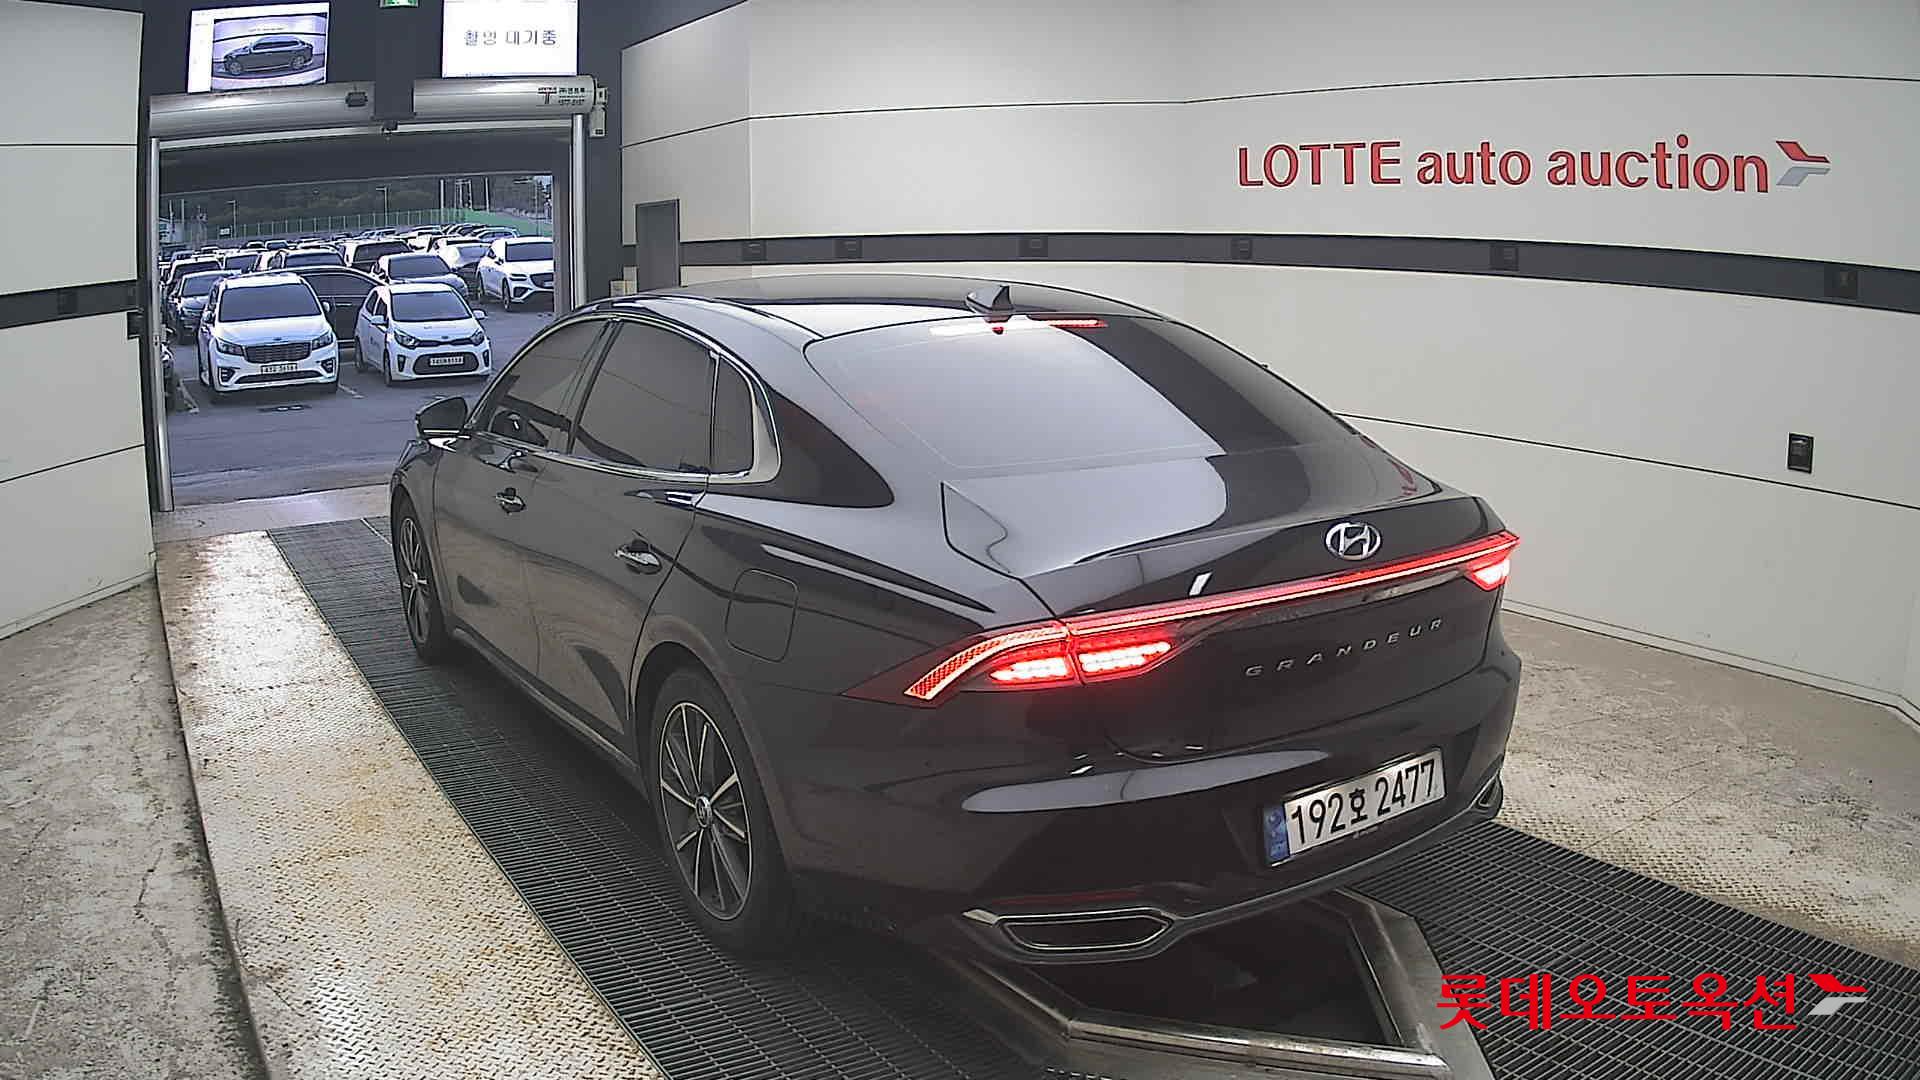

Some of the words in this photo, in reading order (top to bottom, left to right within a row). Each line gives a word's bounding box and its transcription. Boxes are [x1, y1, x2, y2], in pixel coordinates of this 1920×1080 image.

[505, 30, 557, 46] 대기중
[1239, 140, 1401, 188] LOTTE
[1416, 141, 1532, 186] auto
[1547, 133, 1769, 194] auction
[1245, 617, 1442, 677] GRANDEUR
[1291, 787, 1369, 845] 192호
[1375, 758, 1436, 818] 2477
